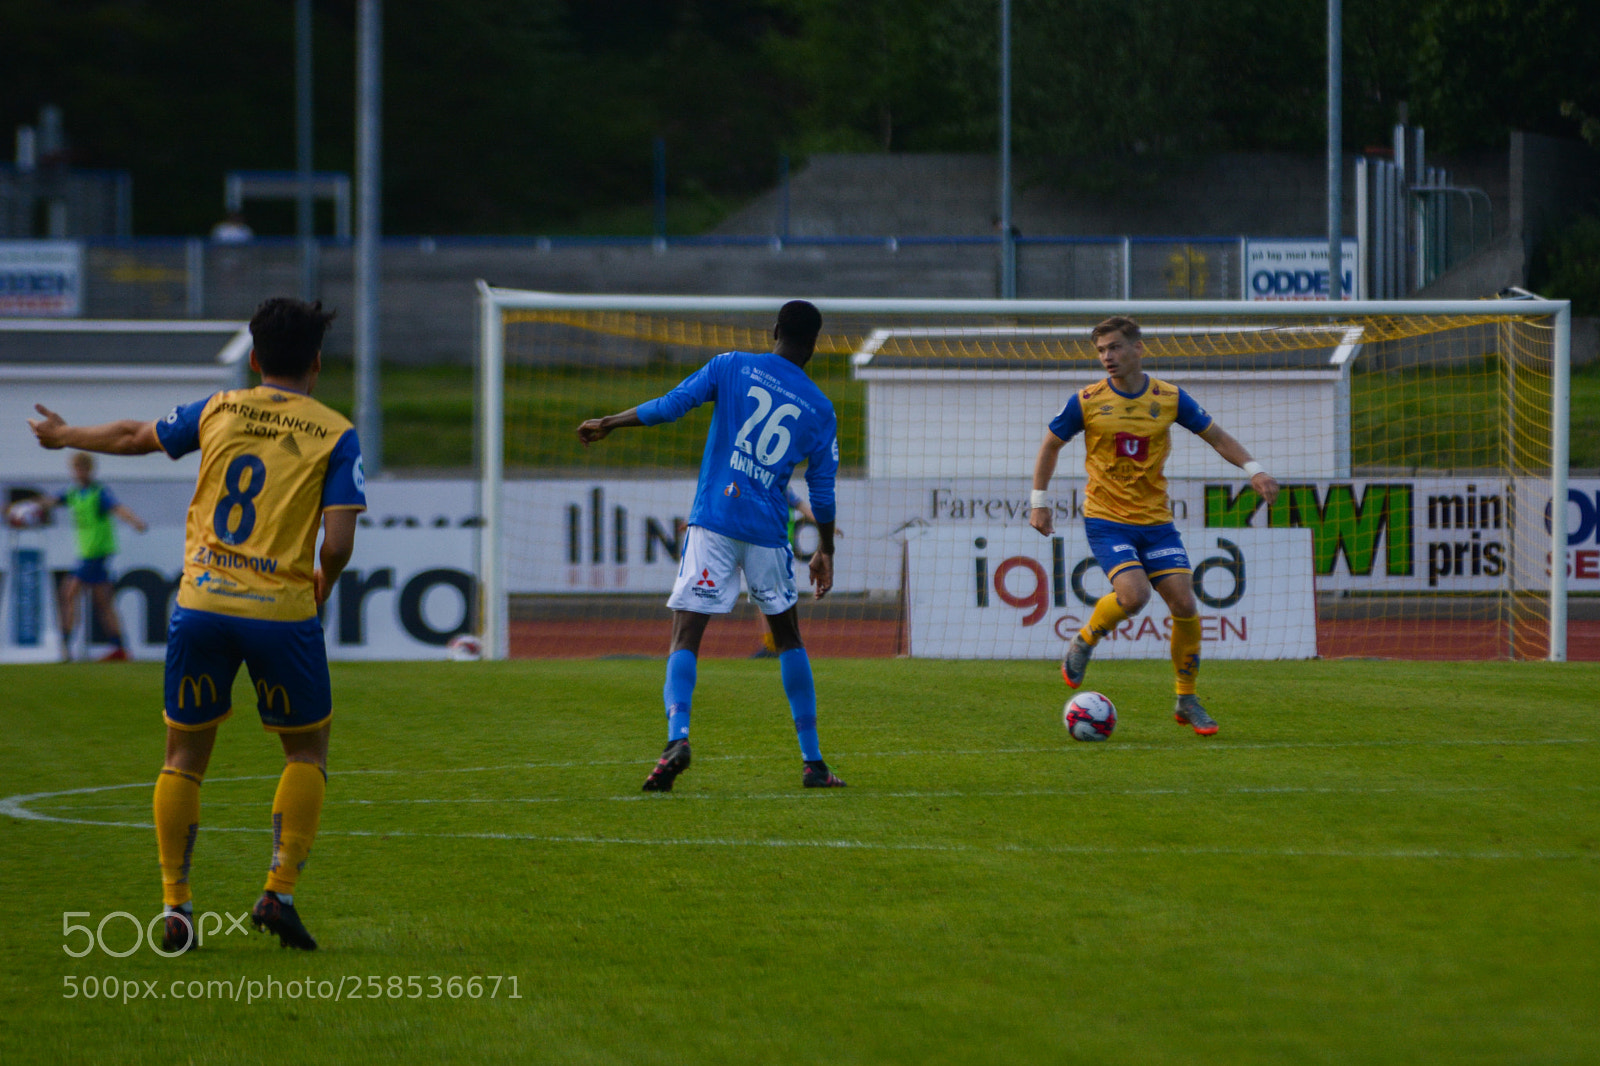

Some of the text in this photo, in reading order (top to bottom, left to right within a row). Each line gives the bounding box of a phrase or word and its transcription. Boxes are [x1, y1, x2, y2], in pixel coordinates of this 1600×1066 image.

[1252, 270, 1353, 295] ODDEN
[204, 402, 328, 439] SPAREBANKEN
[735, 386, 802, 466] 26
[1125, 439, 1139, 456] U
[213, 454, 266, 545] 8
[1428, 485, 1516, 529] mini
[974, 537, 1247, 626] igld
[1428, 533, 1507, 586] pris
[1054, 614, 1248, 642] GRASEN
